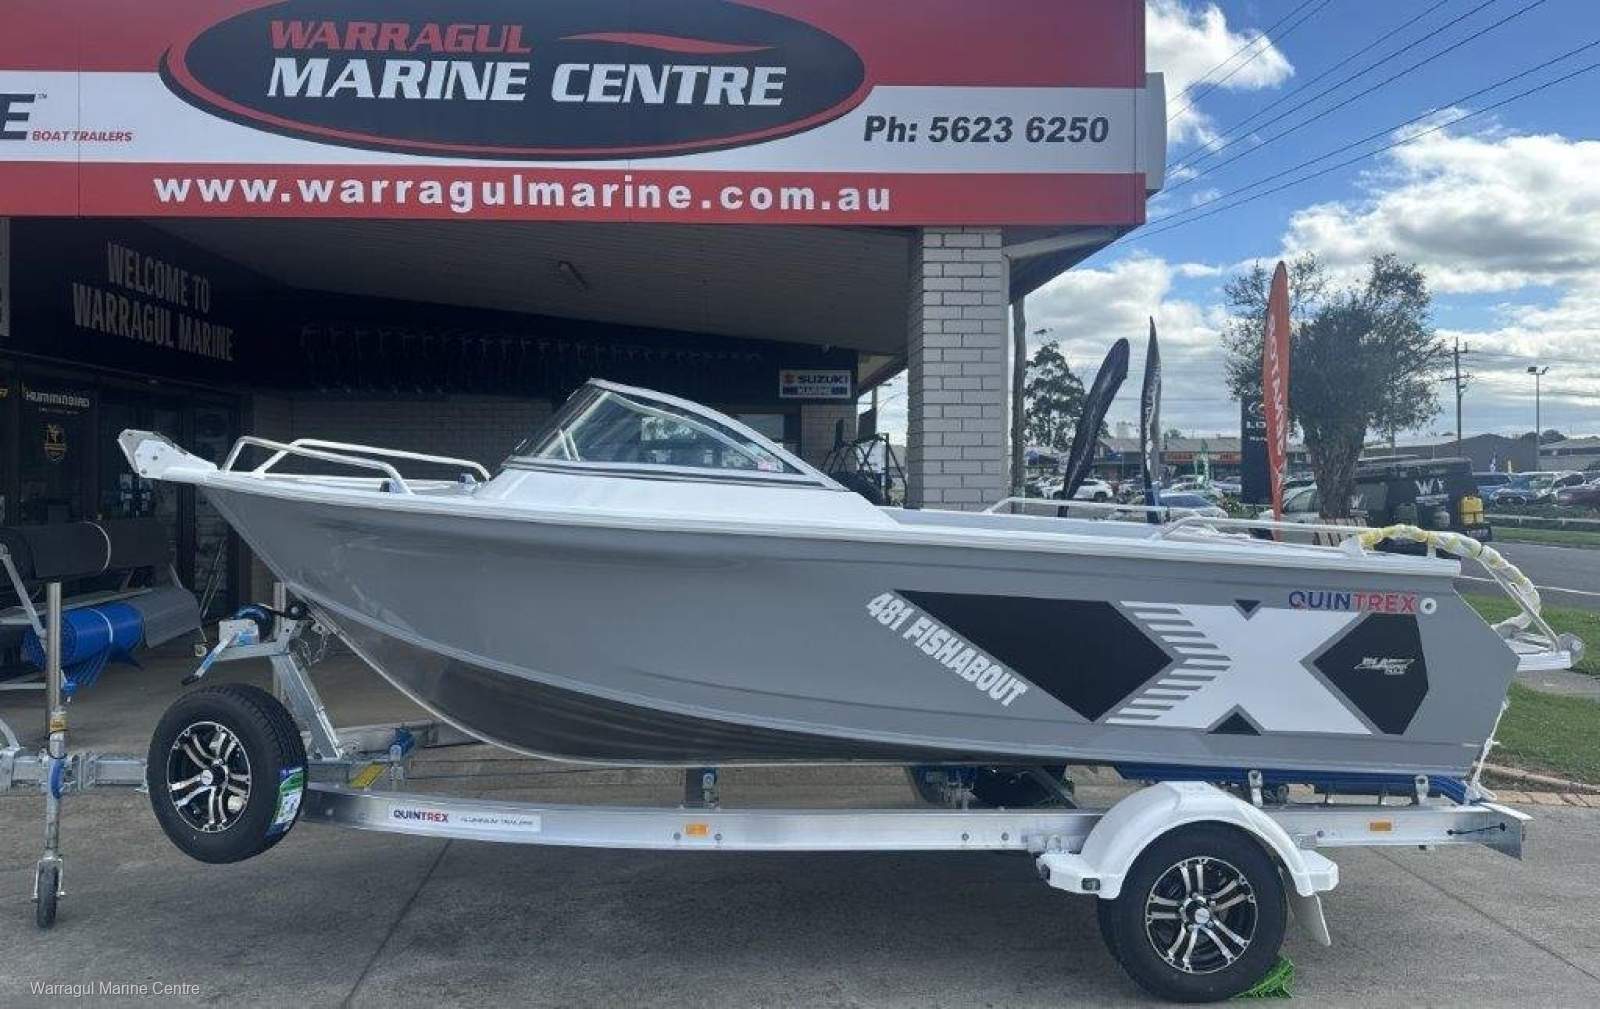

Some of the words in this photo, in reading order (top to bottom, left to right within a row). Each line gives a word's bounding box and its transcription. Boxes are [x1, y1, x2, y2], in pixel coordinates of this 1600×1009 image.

[270, 20, 532, 53] WARRAGUL
[267, 57, 531, 101] MARINE
[551, 63, 787, 106] CENTRE
[32, 130, 70, 142] BOAT
[71, 130, 133, 142] TRAILERS
[863, 115, 918, 142] Ph:
[928, 116, 1013, 143] 5623
[1025, 116, 1110, 143] 6250
[153, 174, 891, 213] www.warragulmarine.com.au
[106, 240, 189, 307] WELCOME
[191, 273, 209, 314] TO
[72, 281, 175, 348] WARRAGUL
[177, 313, 234, 361] MARINE
[798, 374, 850, 385] SUZUKI
[1289, 590, 1418, 613] QUINTREX
[866, 592, 914, 631] 481
[903, 616, 1029, 707] FISHABOUT
[393, 809, 449, 823] QUINTREX
